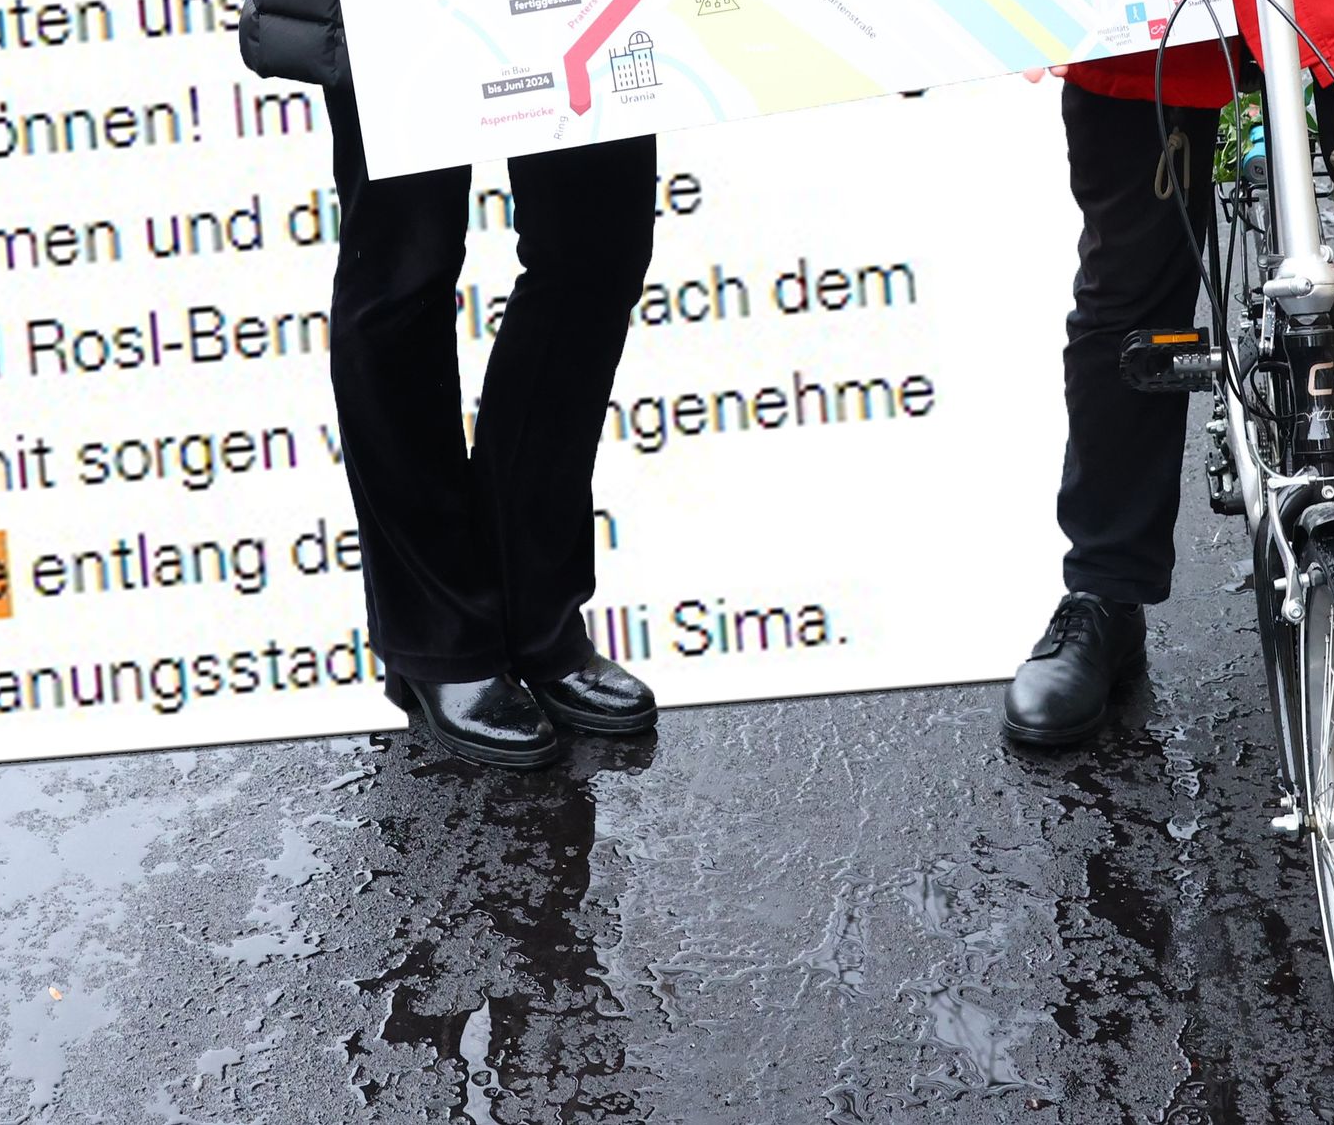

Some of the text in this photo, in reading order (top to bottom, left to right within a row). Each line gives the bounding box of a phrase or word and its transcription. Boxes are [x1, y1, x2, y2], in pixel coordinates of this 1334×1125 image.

[501, 66, 530, 77] in Bau
[487, 75, 550, 95] bis Juni 2024
[620, 92, 656, 104] Urania
[480, 106, 554, 127] Aspernbrücke
[553, 115, 569, 140] Ring
